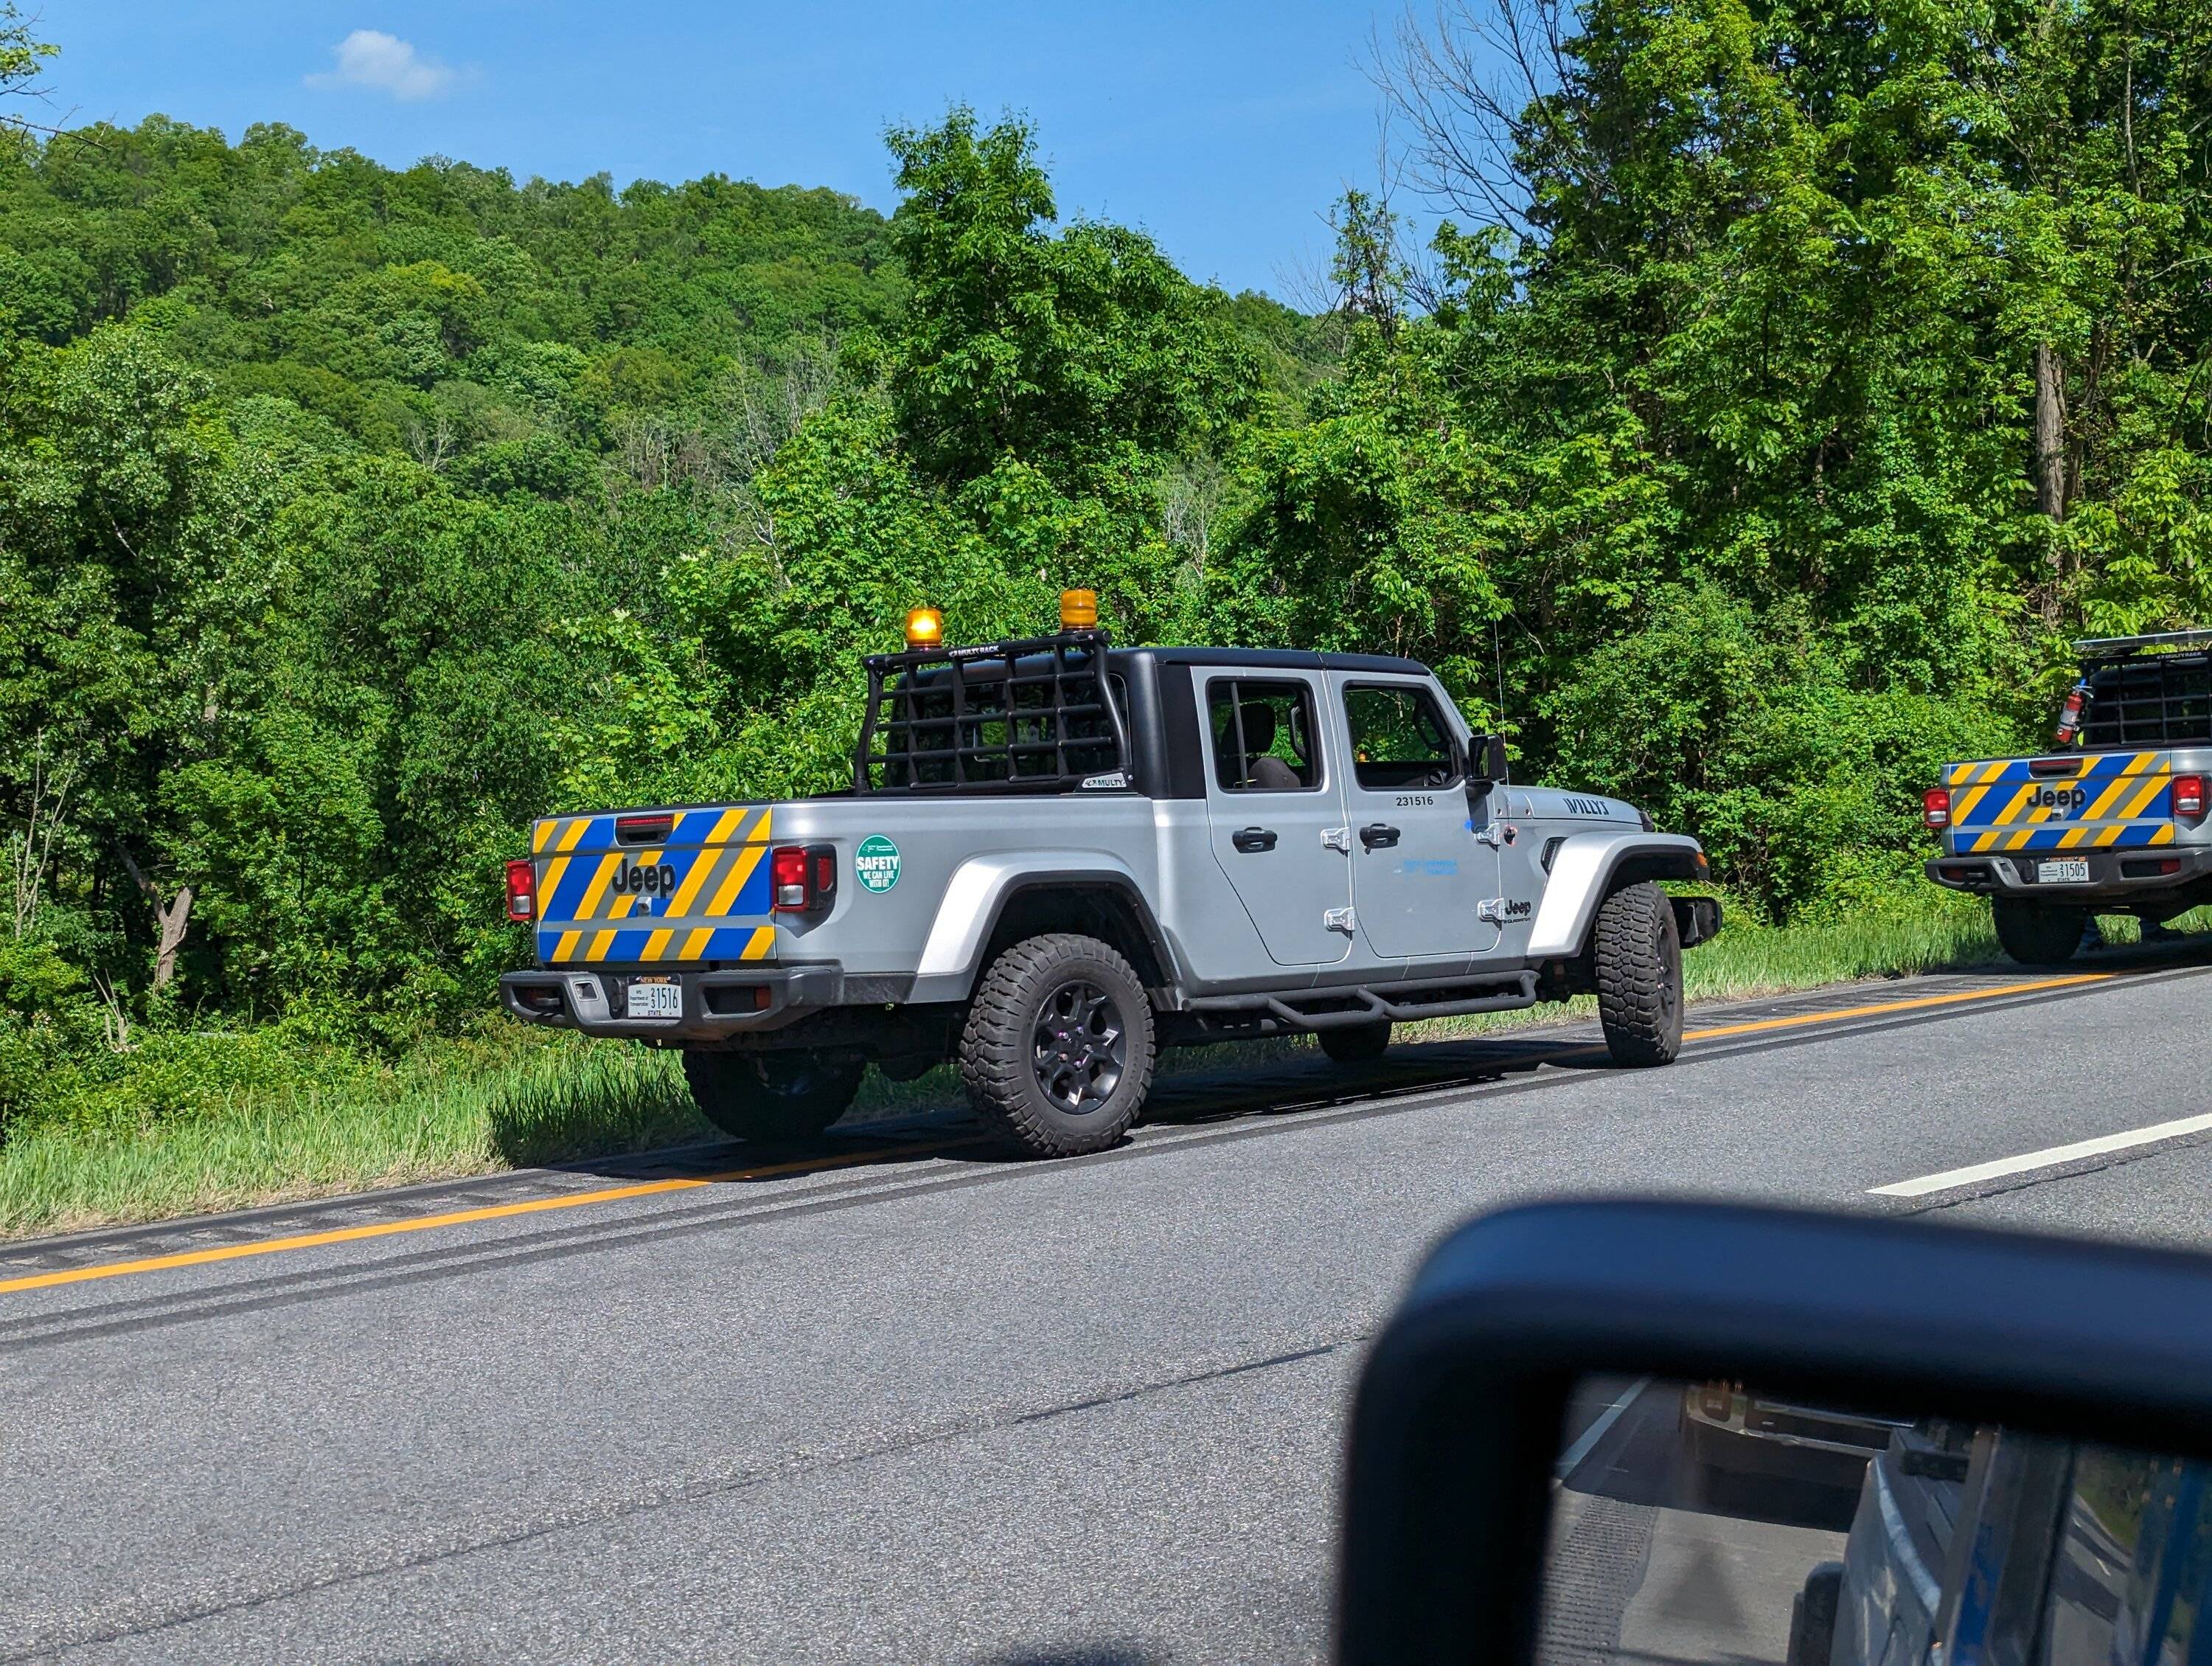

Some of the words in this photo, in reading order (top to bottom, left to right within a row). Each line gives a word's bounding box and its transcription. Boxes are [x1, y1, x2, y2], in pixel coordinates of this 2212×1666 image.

[1396, 796, 1433, 807] 231516
[2027, 785, 2087, 810] Jeep
[1562, 798, 1610, 815] WILLYS
[857, 855, 899, 870] SAFETY
[2065, 863, 2085, 877] 1505
[612, 858, 675, 900] Jeep
[863, 871, 872, 879] WE
[872, 870, 883, 879] CAN
[883, 870, 894, 879] LIVE
[1505, 899, 1531, 917] Jeep
[657, 988, 678, 1009] 1516
